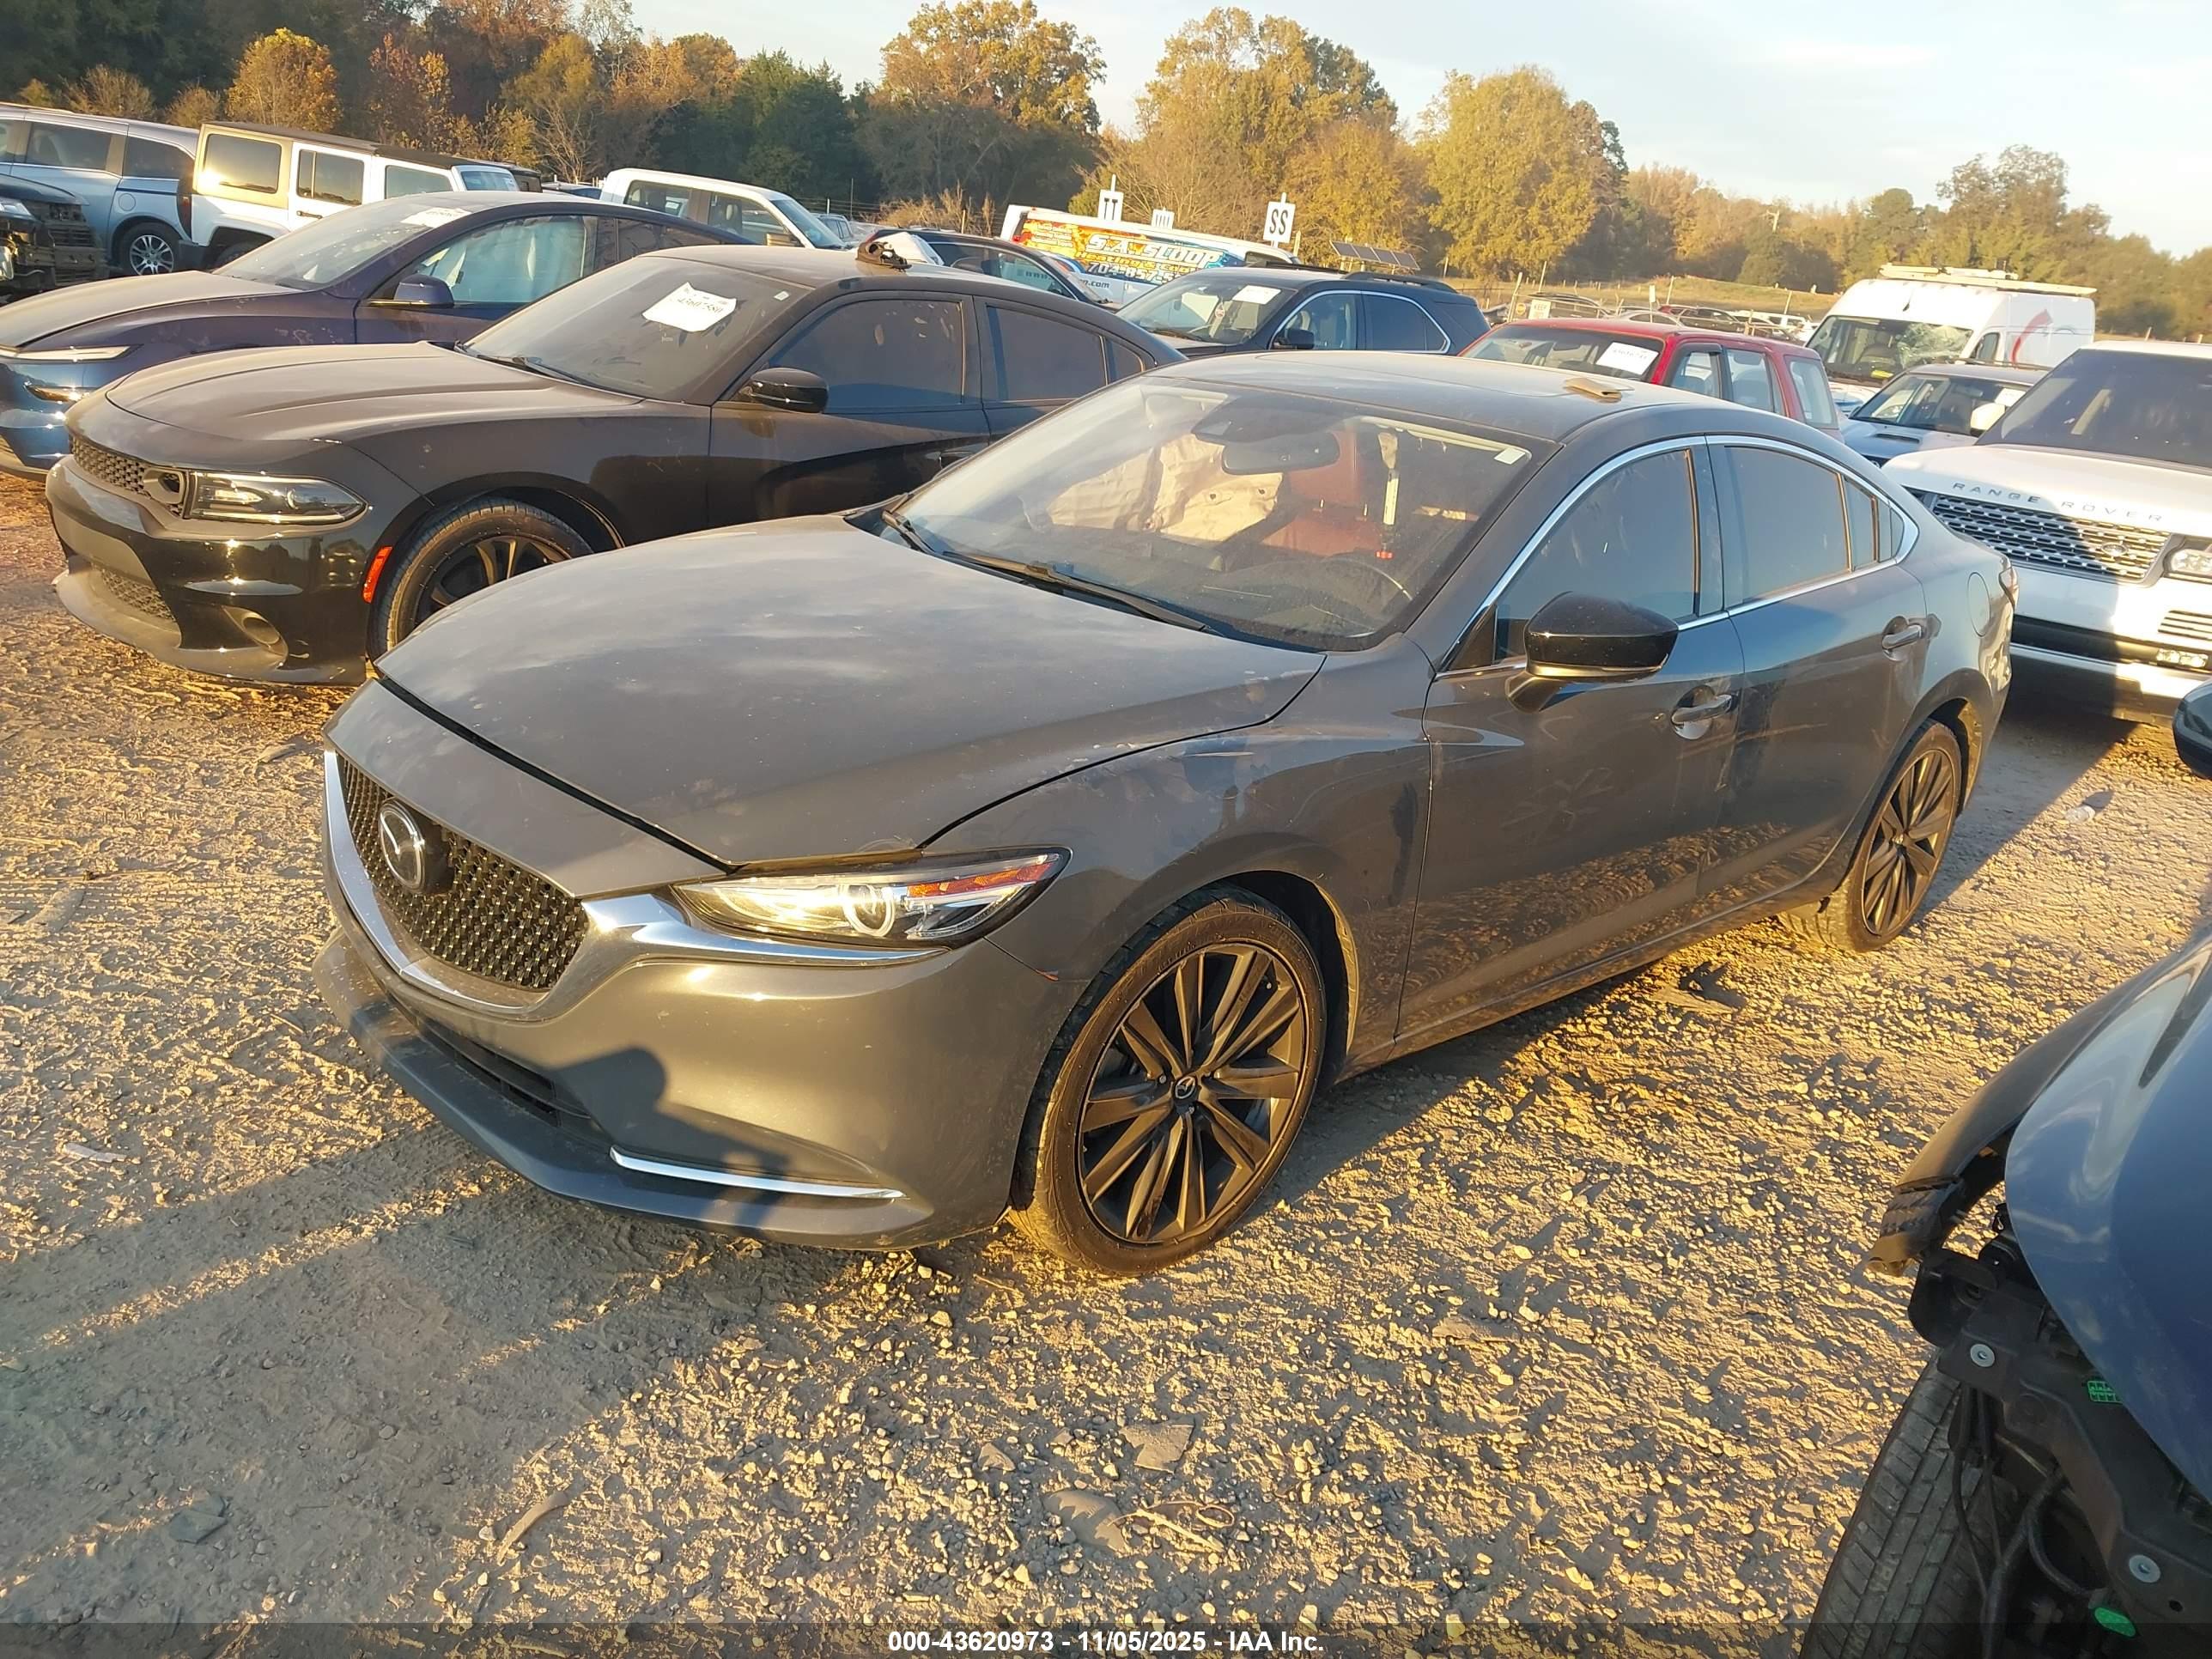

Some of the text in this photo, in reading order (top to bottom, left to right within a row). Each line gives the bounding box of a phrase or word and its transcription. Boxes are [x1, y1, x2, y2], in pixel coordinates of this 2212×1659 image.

[1269, 209, 1288, 235] SS
[1953, 482, 2162, 522] RANGE ROVER
